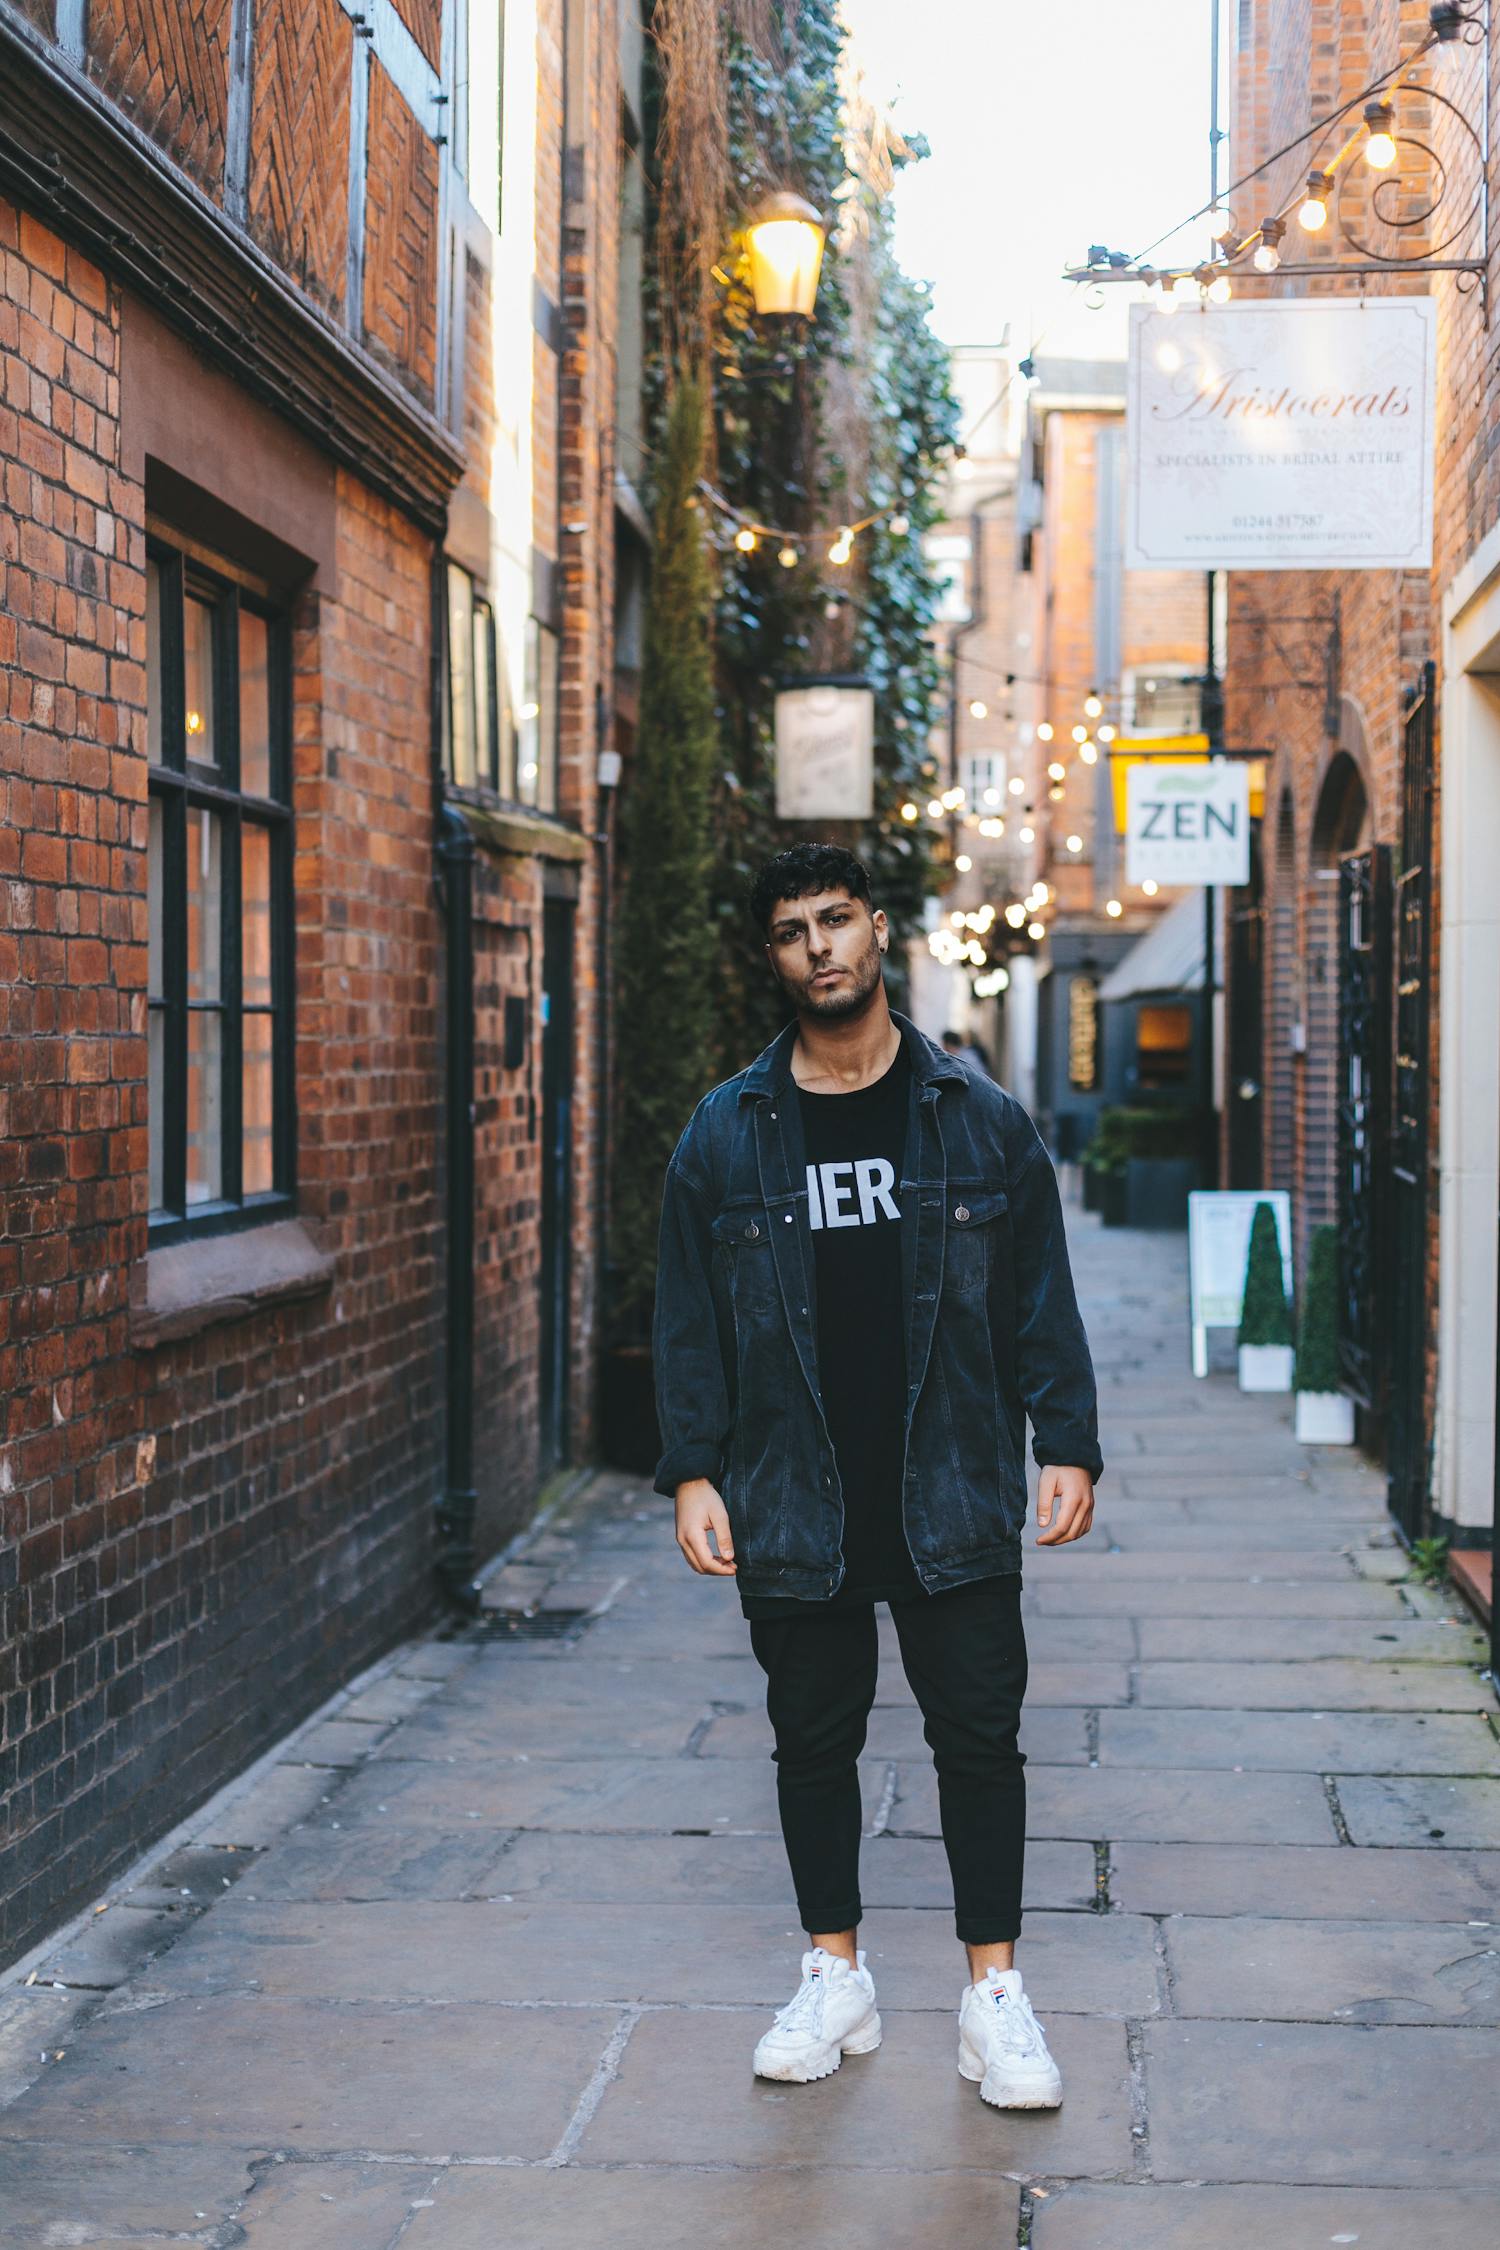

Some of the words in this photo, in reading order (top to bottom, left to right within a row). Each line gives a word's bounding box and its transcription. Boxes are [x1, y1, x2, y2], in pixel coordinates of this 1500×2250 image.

[1152, 367, 1413, 422] Aristocrats
[1156, 453, 1253, 467] SPECIALISTS
[1259, 453, 1276, 466] IN
[1283, 452, 1338, 466] BRIDAL
[1348, 451, 1403, 465] ATTIRE
[1139, 801, 1237, 839] ZEN
